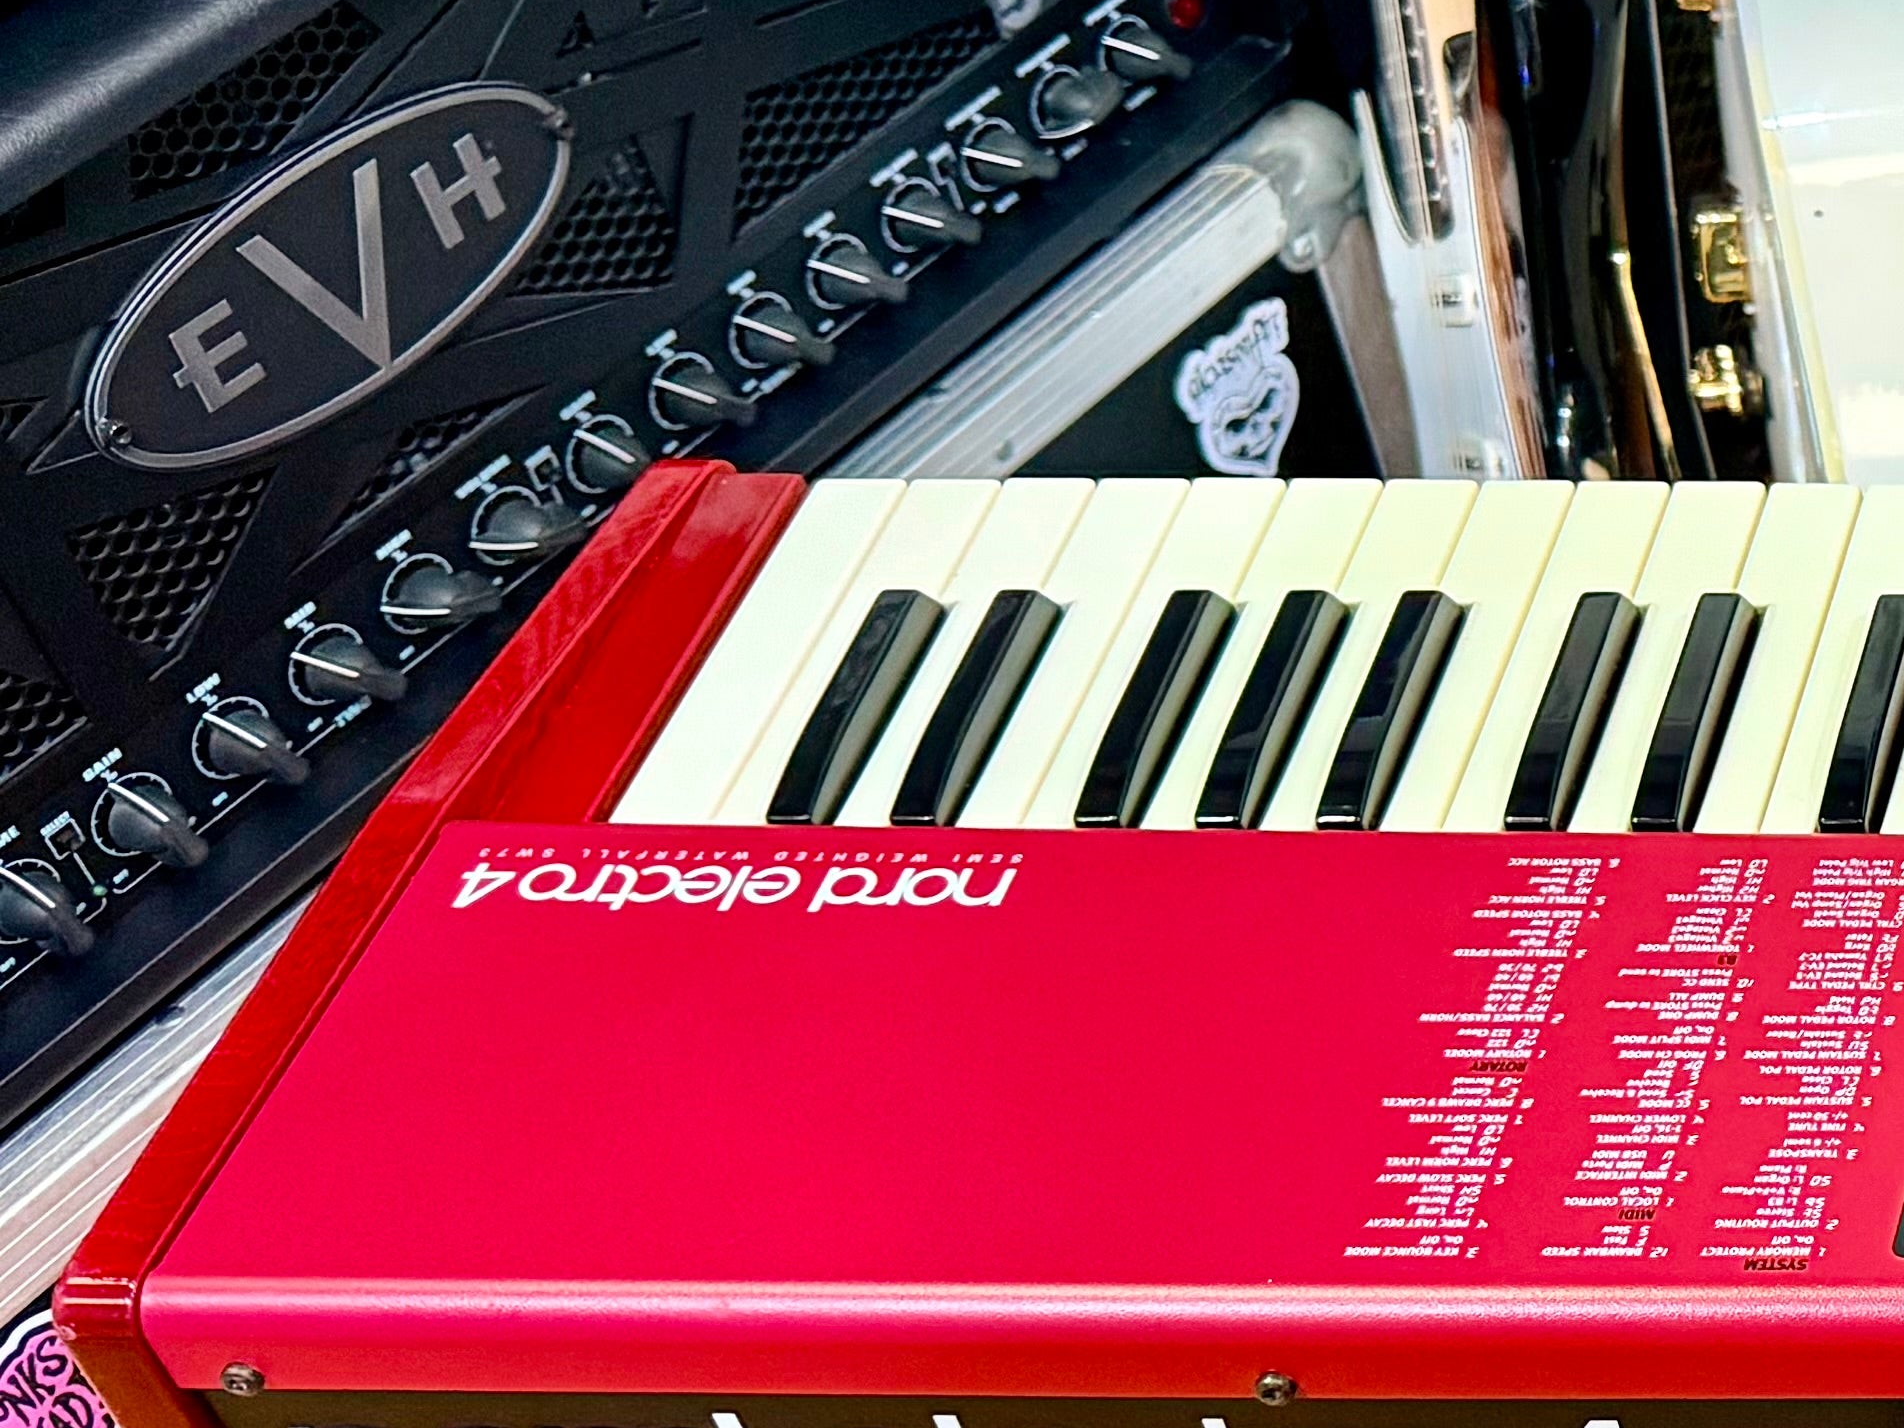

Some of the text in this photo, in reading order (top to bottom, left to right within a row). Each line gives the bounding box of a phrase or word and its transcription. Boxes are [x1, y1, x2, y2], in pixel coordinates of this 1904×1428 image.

[170, 132, 505, 414] EVH
[582, 849, 750, 861] WATERFALL
[774, 851, 930, 863] WEIGHTED
[952, 854, 1023, 863] SEMI
[518, 863, 799, 912] electro
[808, 868, 1017, 913] nord
[1743, 1259, 1808, 1271] SYSTEM
[0, 1338, 72, 1423] NKS
